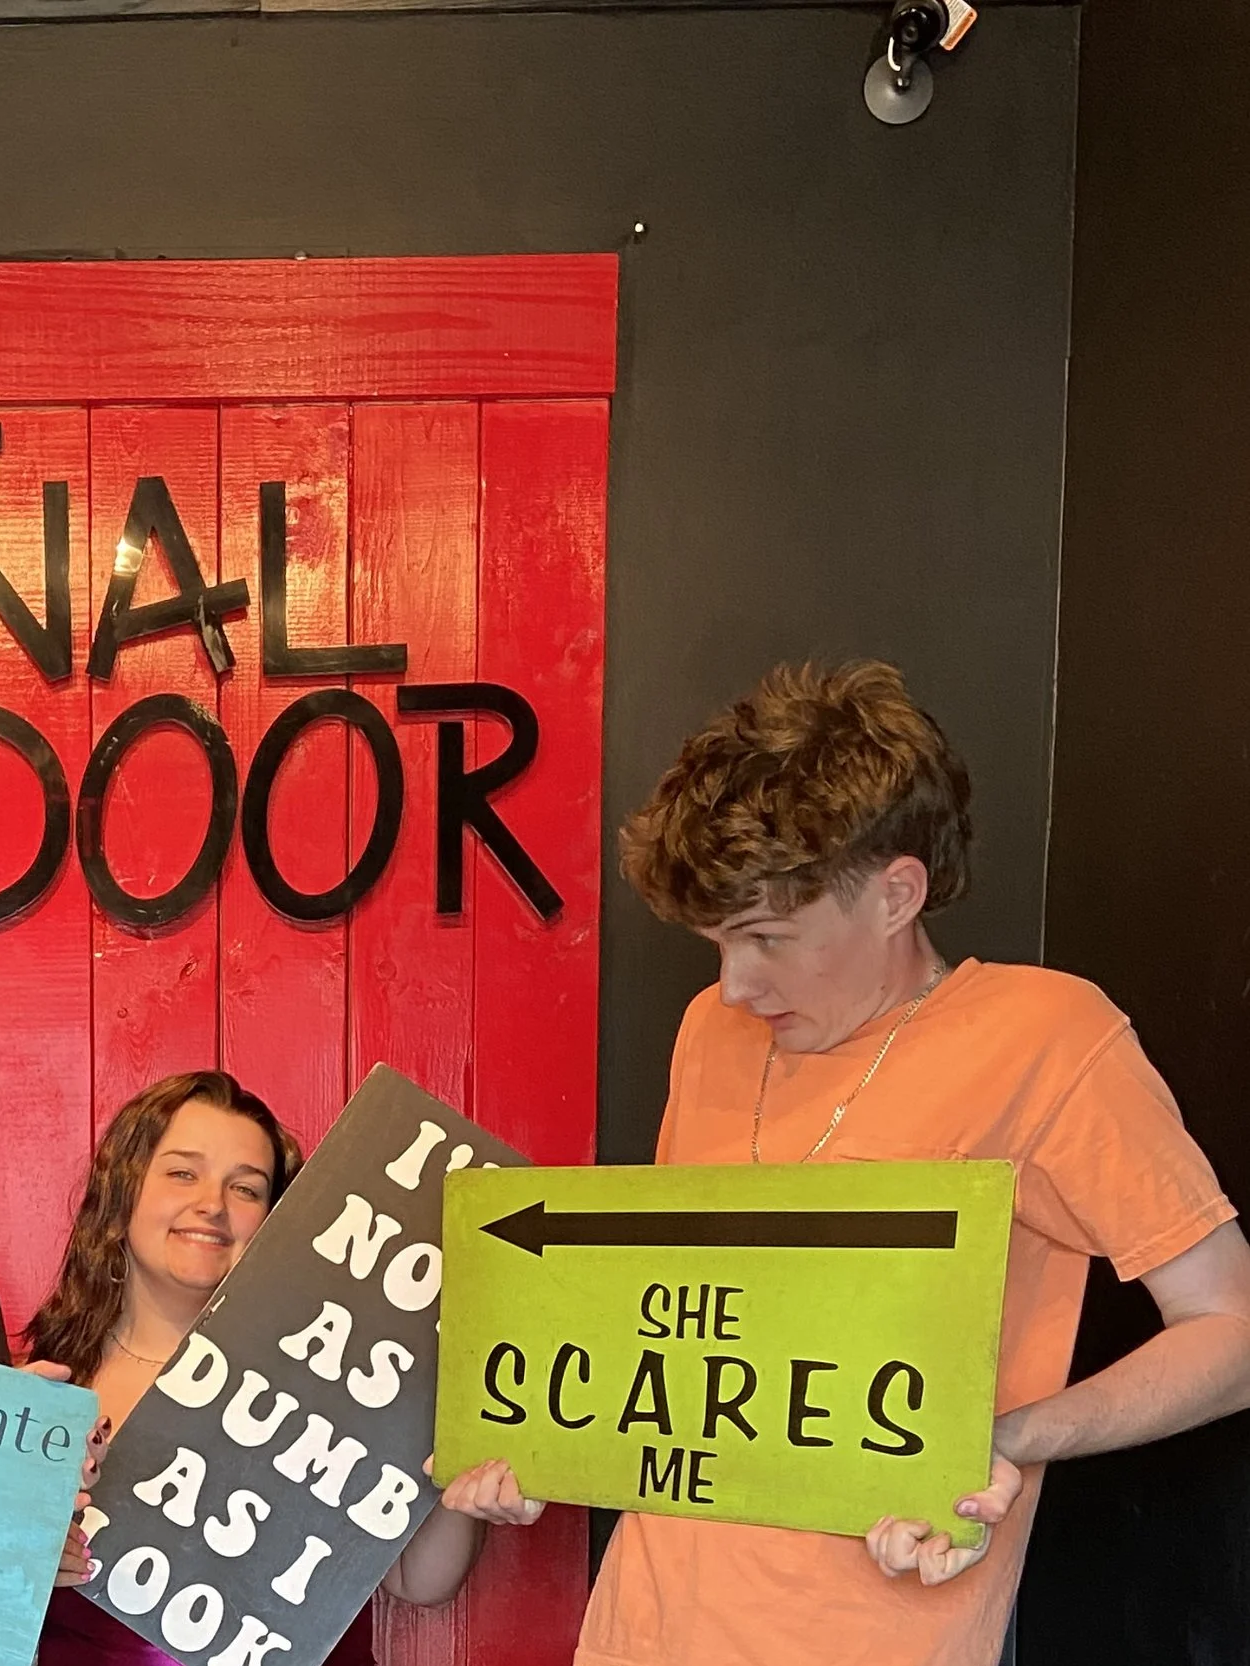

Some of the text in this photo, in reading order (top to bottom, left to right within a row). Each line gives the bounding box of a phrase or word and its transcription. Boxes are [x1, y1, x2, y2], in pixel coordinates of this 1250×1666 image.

[384, 1120, 500, 1190] I'
[312, 1193, 443, 1320] NO
[637, 1283, 744, 1341] SHE
[278, 1300, 415, 1409] AS
[480, 1341, 925, 1457] SCARES
[156, 1332, 420, 1540] DUMB
[638, 1446, 718, 1504] ME
[132, 1446, 333, 1606] AS I
